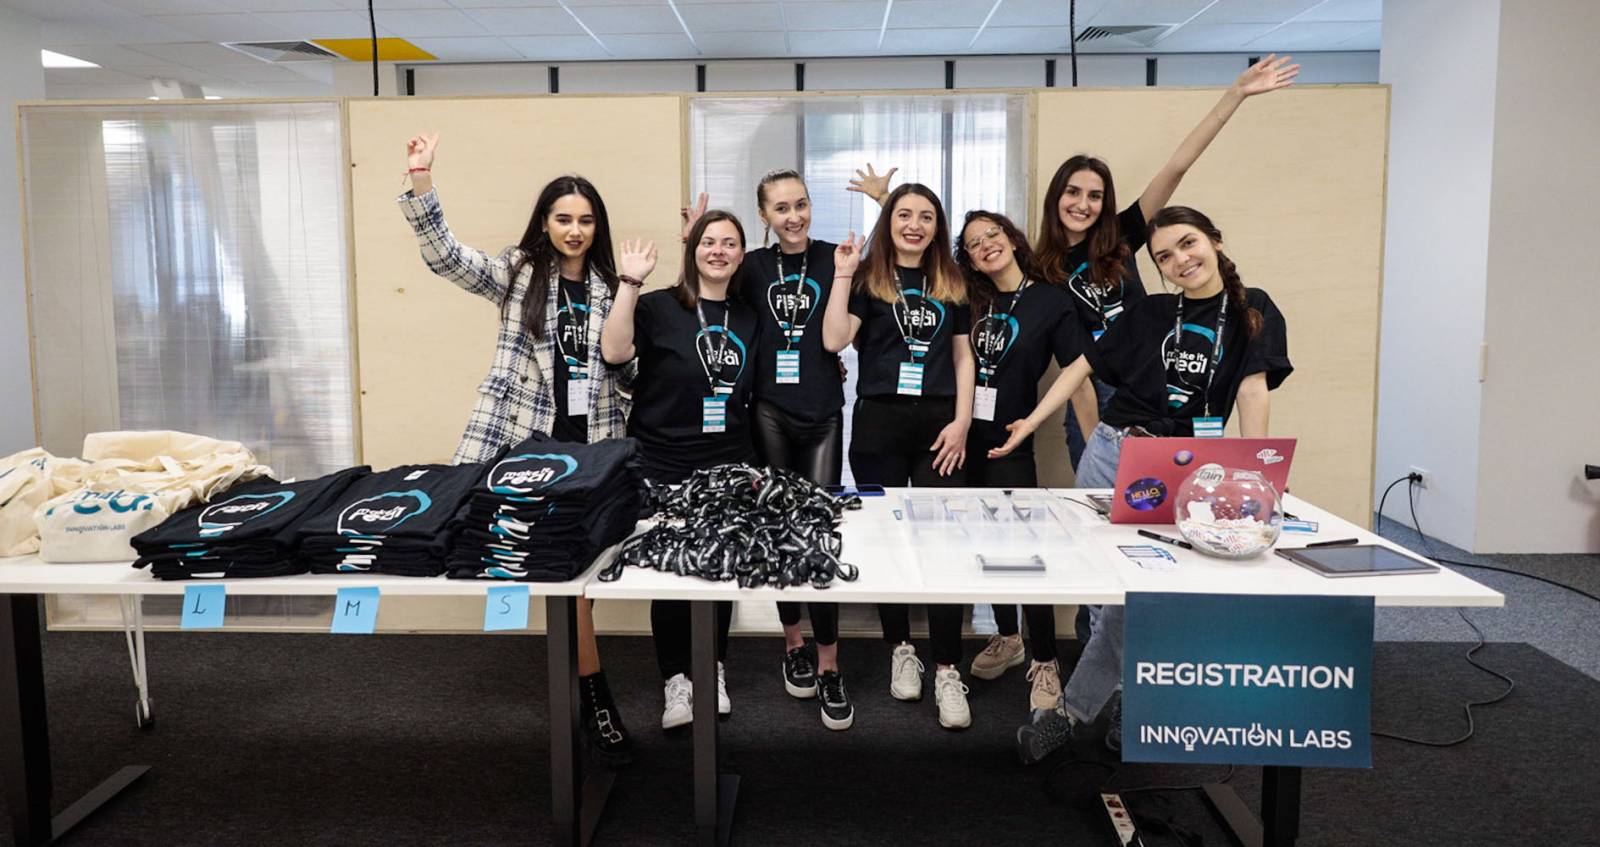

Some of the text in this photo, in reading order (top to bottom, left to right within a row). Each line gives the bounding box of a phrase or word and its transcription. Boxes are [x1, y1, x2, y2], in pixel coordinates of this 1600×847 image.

[1165, 358, 1208, 374] real
[496, 470, 555, 485] real
[192, 593, 206, 615] L
[344, 600, 361, 617] M
[499, 595, 511, 615] S
[1136, 662, 1354, 689] REGISTRATION
[1140, 723, 1352, 751] INNOVATION LABS
